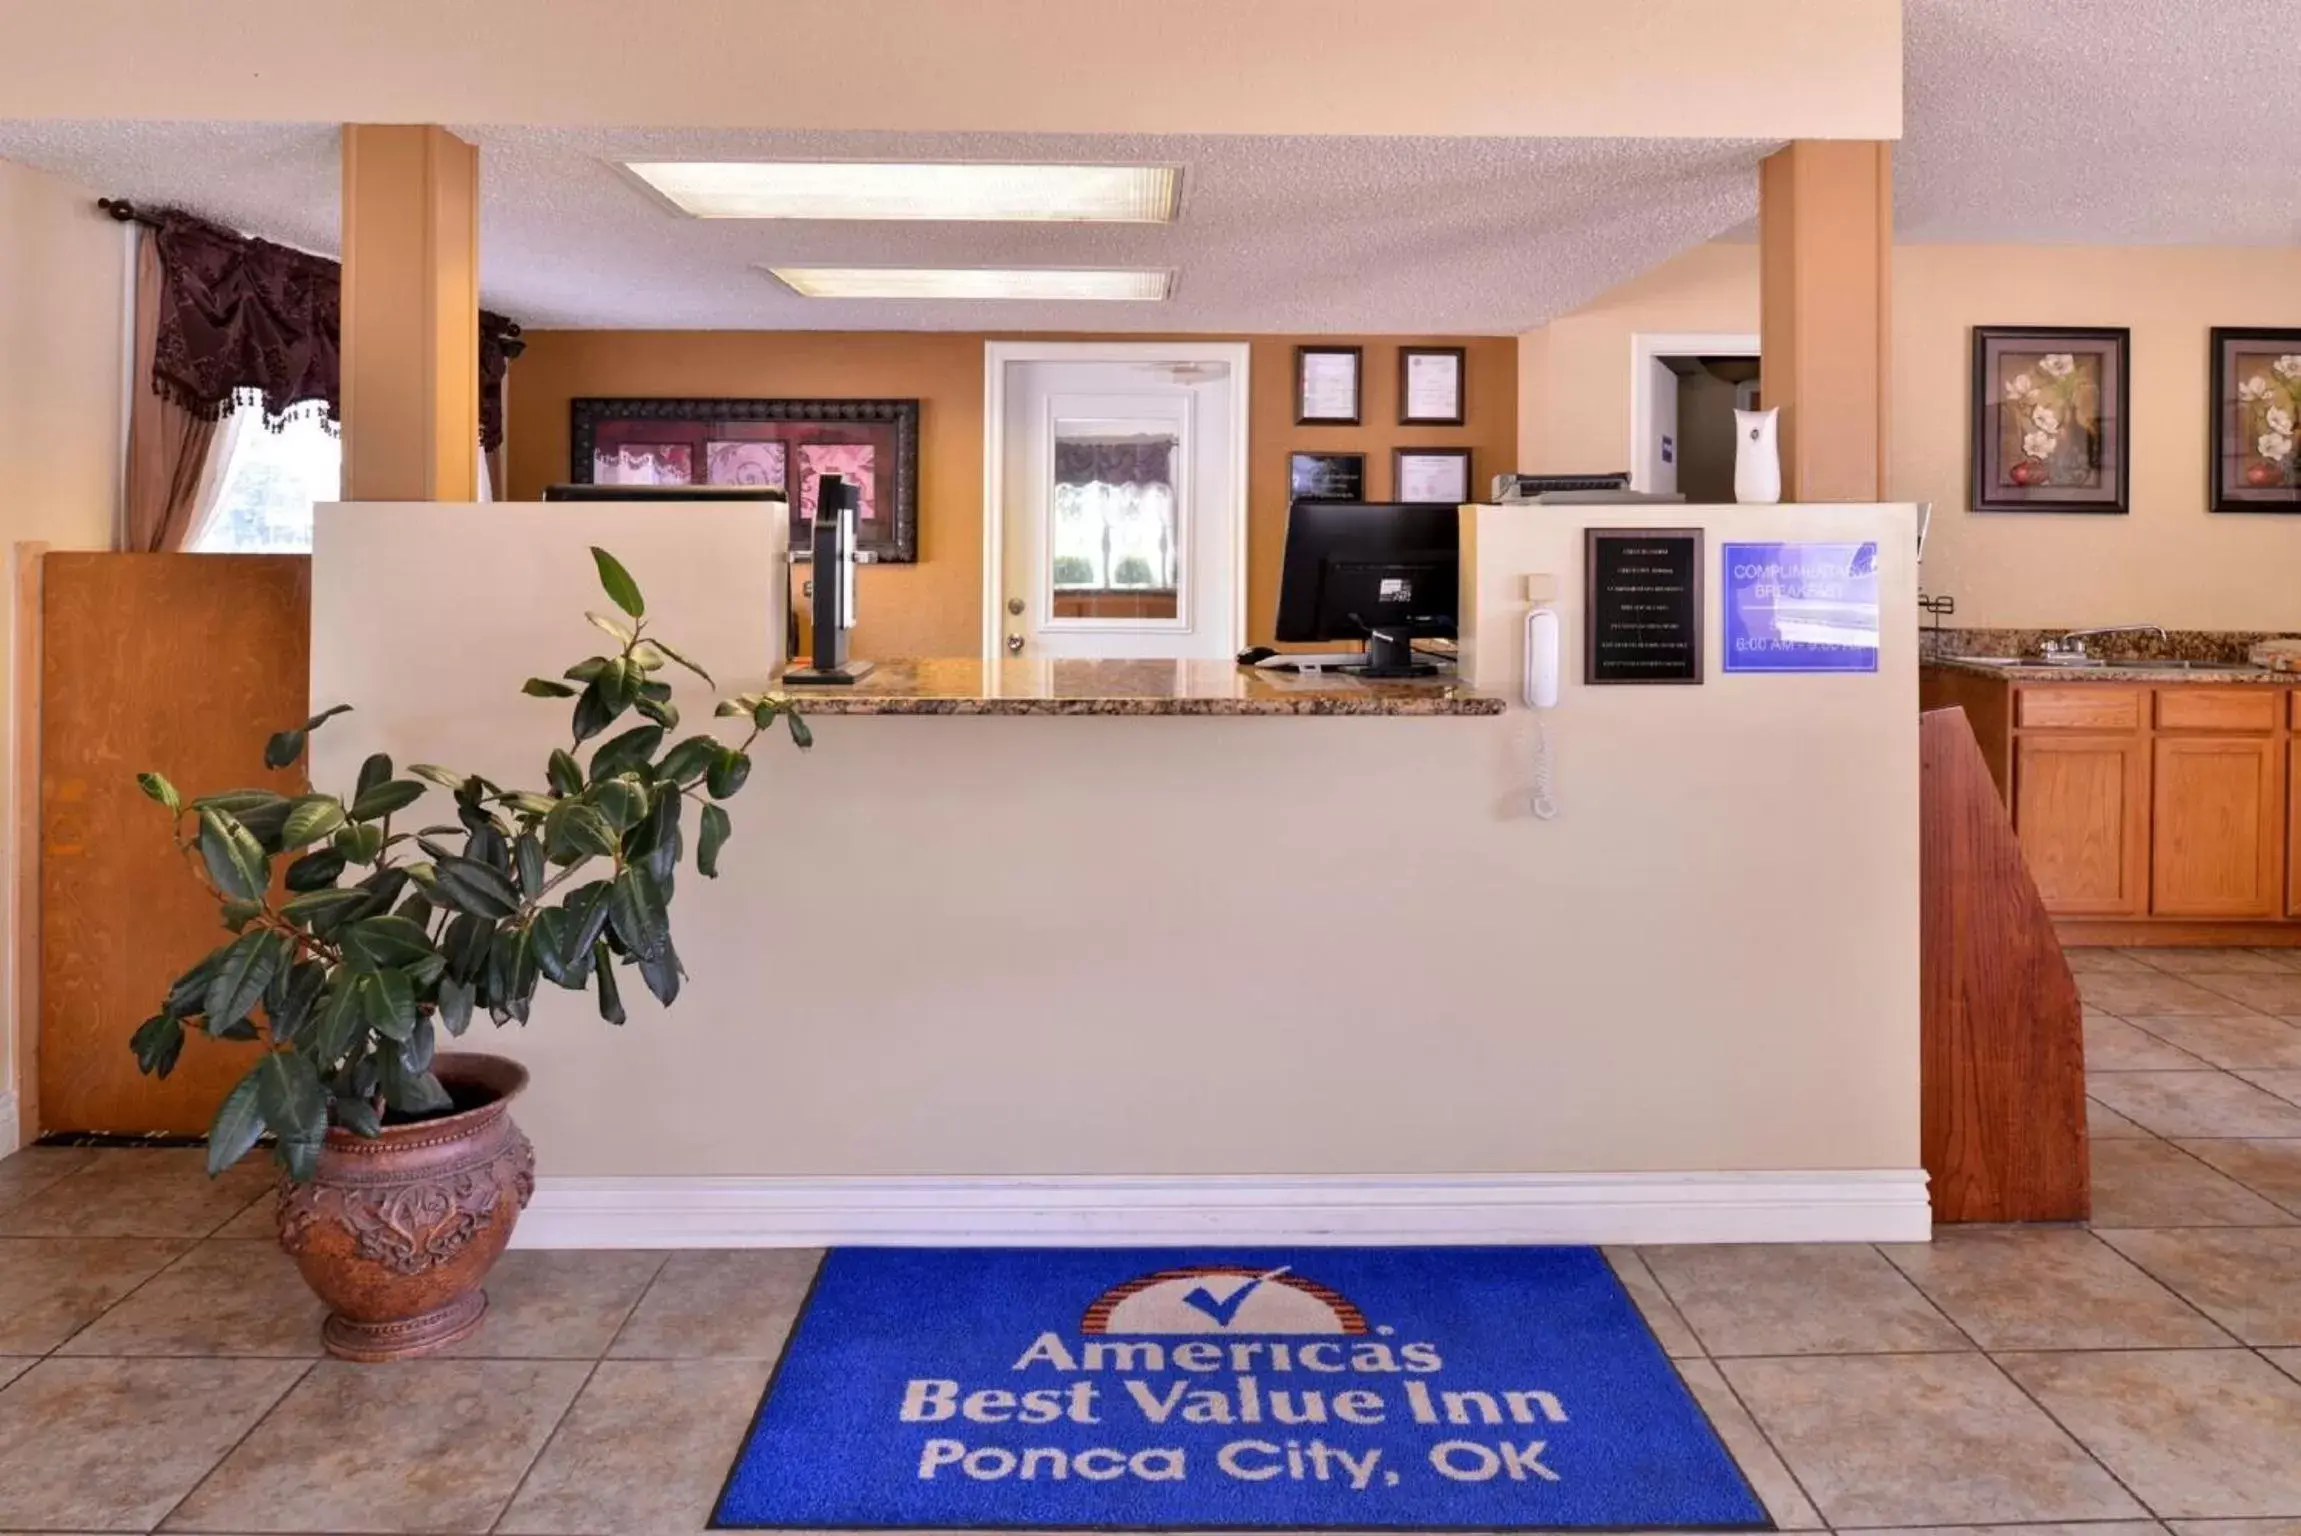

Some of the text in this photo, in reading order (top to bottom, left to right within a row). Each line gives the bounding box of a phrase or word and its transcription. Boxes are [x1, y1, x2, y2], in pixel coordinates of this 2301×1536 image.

[1011, 1325, 1443, 1372] America's
[899, 1376, 1569, 1424] Best Value Inn
[917, 1438, 1561, 1490] Ponca City, OK
